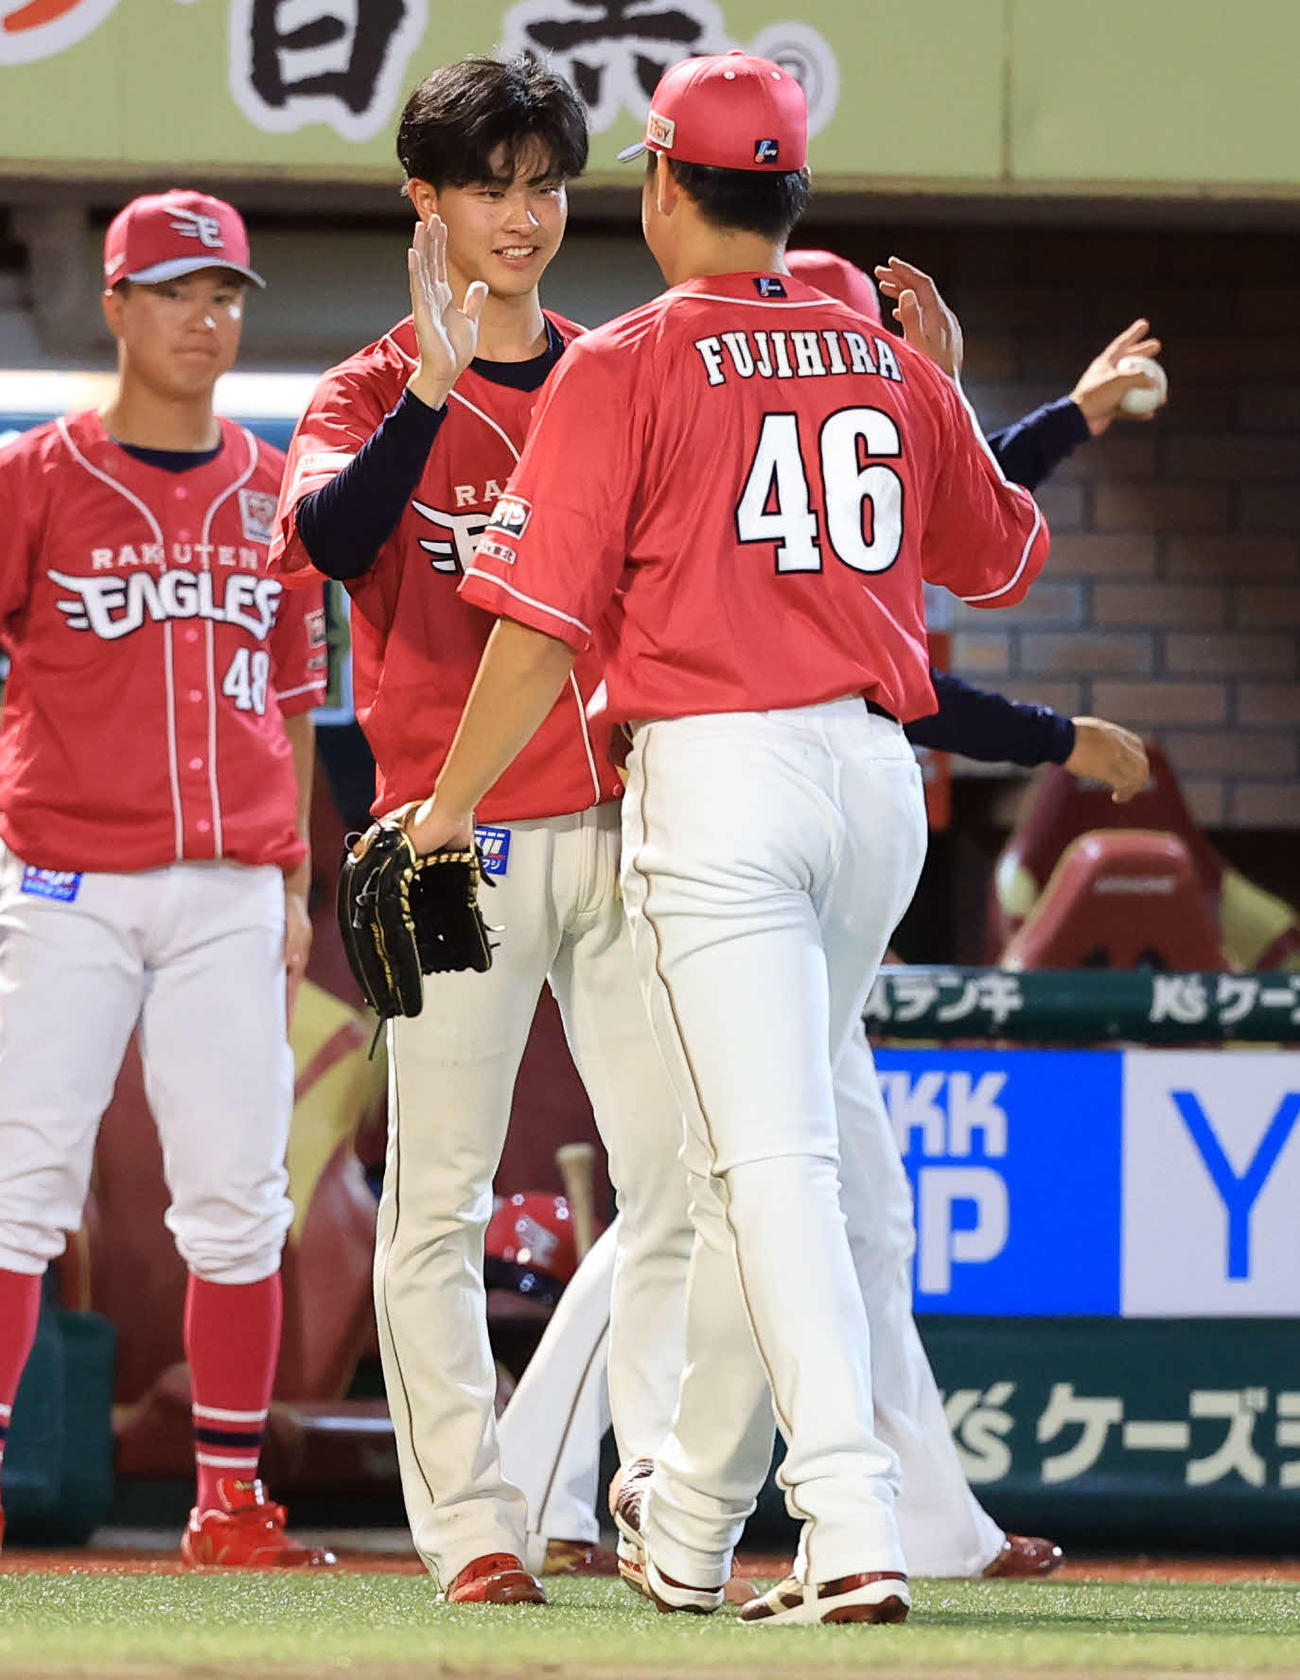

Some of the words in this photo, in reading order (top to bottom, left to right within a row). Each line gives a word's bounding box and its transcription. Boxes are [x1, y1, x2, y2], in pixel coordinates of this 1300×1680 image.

[694, 329, 903, 387] FUJIHIRA
[735, 405, 904, 575] 46
[91, 543, 260, 571] RAKUTEN
[47, 568, 283, 642] EAGLES
[222, 647, 270, 716] 48
[1216, 972, 1300, 1024] ケー
[877, 1070, 1009, 1158] KK
[1169, 1089, 1300, 1280] Y
